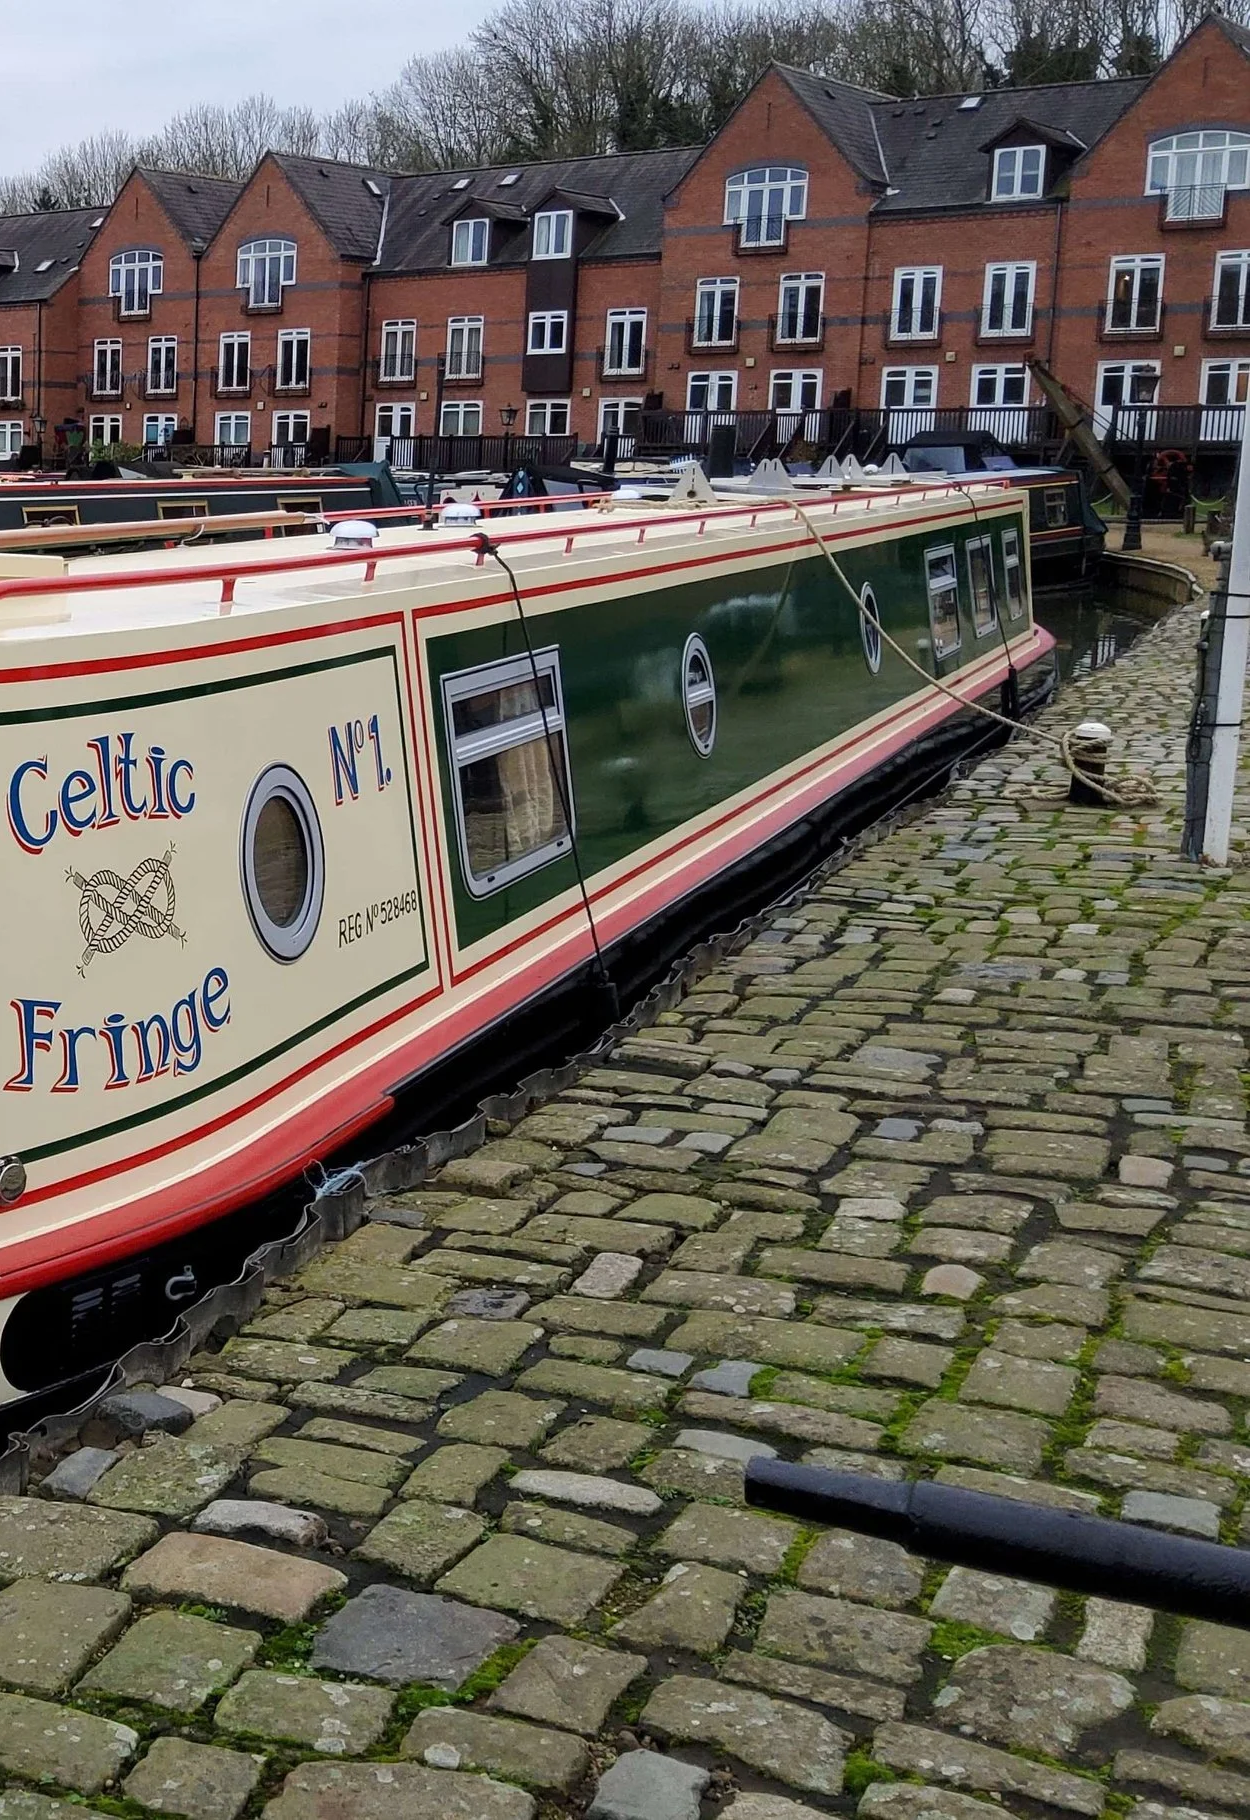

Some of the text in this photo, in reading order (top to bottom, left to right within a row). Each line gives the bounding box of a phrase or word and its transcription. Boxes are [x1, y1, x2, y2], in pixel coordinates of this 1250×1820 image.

[6, 732, 196, 855] Celtic
[338, 912, 362, 948] REG
[2, 967, 231, 1093] Fringe
